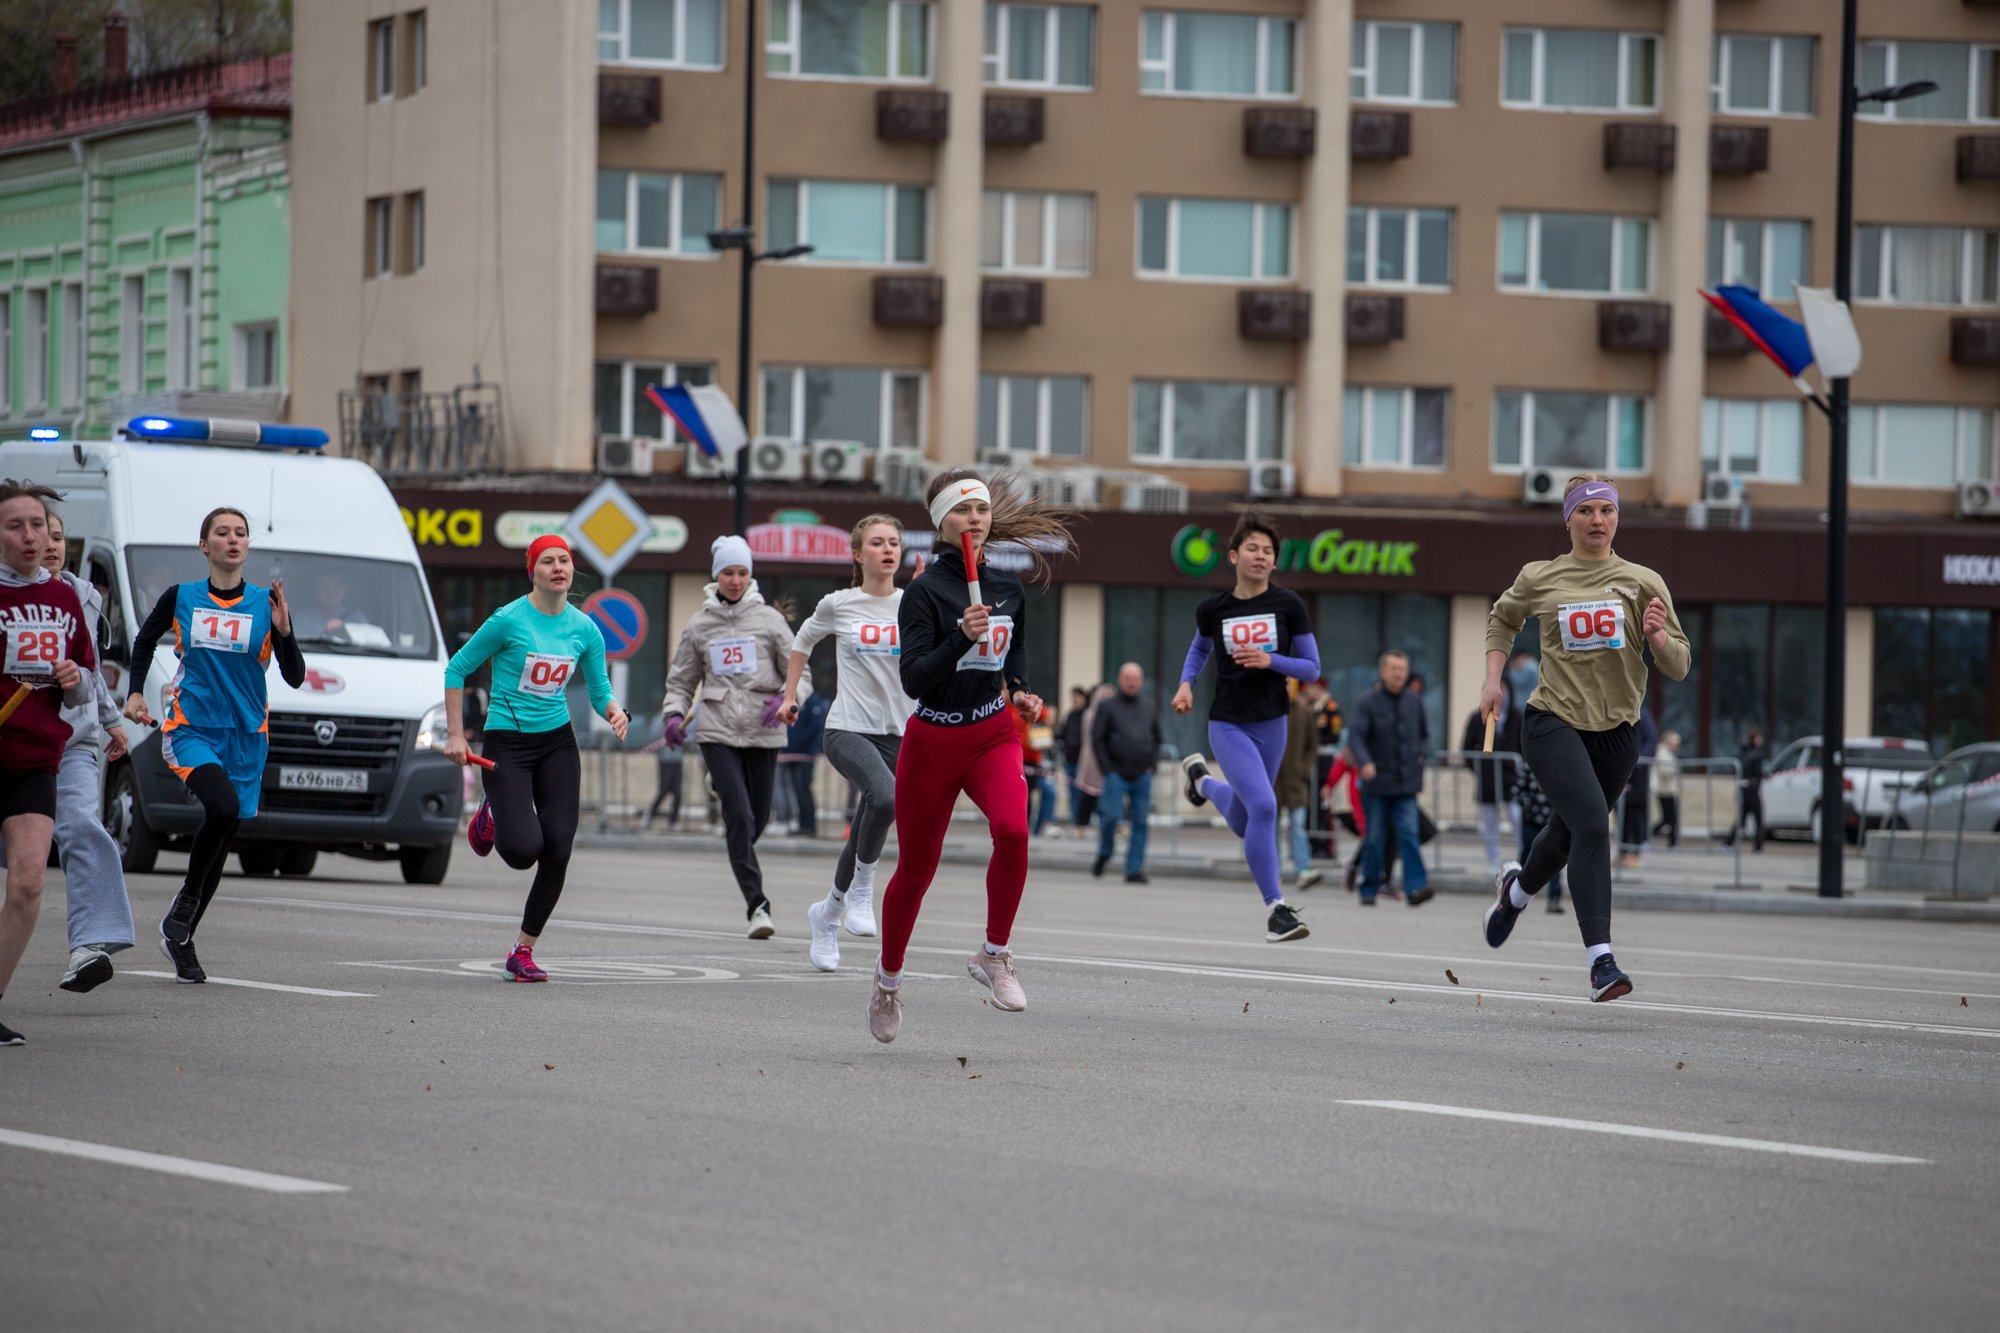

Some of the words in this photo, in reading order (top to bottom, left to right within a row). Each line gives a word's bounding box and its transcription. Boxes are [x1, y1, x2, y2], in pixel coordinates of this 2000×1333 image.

[1278, 528, 1420, 575] пбанк
[202, 616, 240, 641] 11
[861, 624, 896, 646] 01
[1231, 622, 1269, 645] 02
[1569, 610, 1615, 639] 06
[17, 632, 59, 661] 28
[722, 646, 743, 665] 25
[531, 662, 569, 686] 04
[920, 708, 963, 723] PRO
[972, 695, 1005, 720] NIKE
